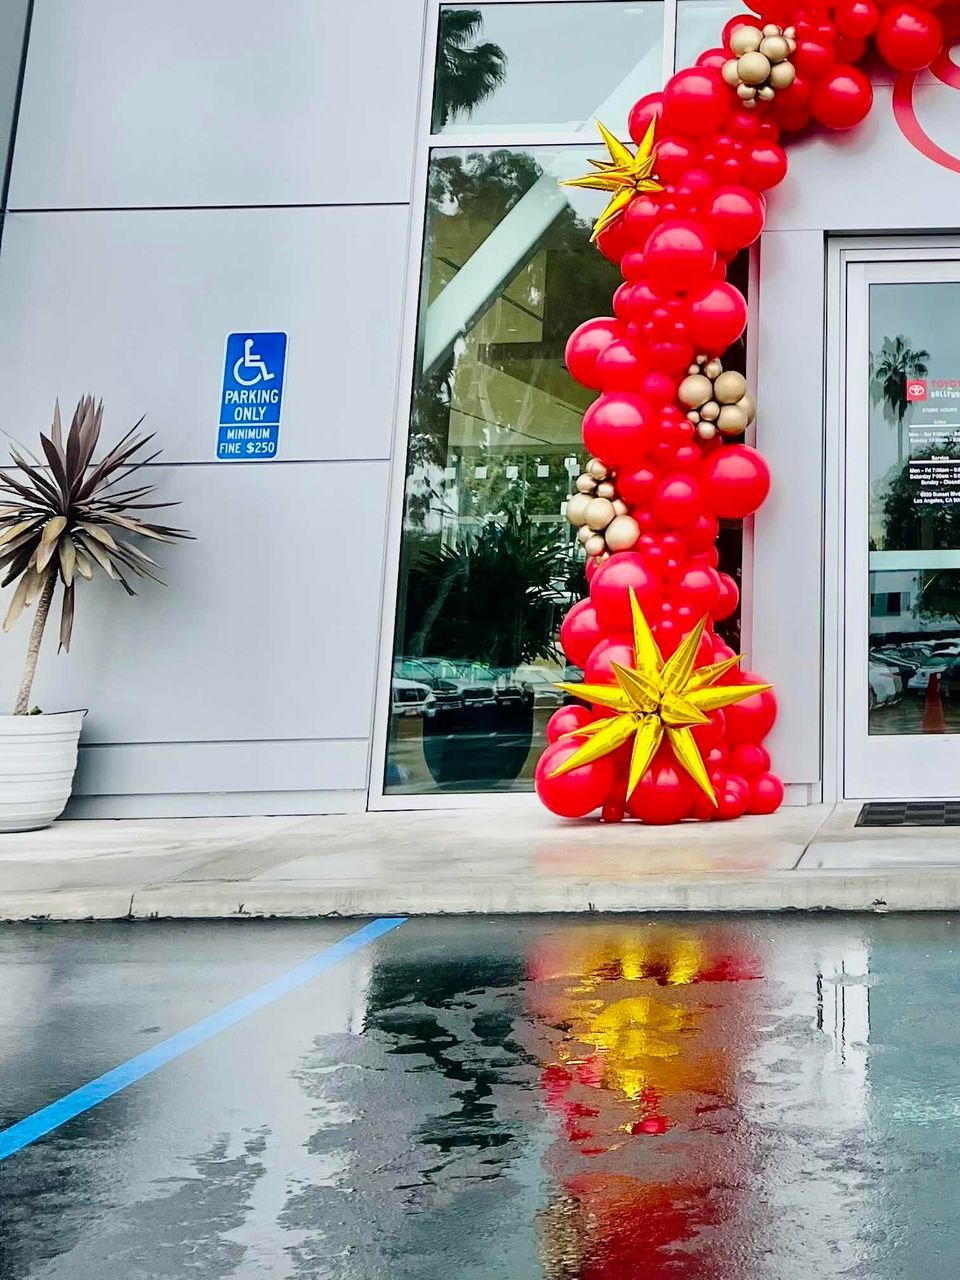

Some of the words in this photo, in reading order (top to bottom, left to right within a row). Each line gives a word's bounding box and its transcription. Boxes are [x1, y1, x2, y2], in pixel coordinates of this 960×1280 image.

[225, 389, 278, 404] PARKING
[234, 406, 267, 420] ONLY
[227, 428, 270, 440] MINIMUM
[220, 443, 241, 454] FINE
[246, 442, 274, 454] $250
